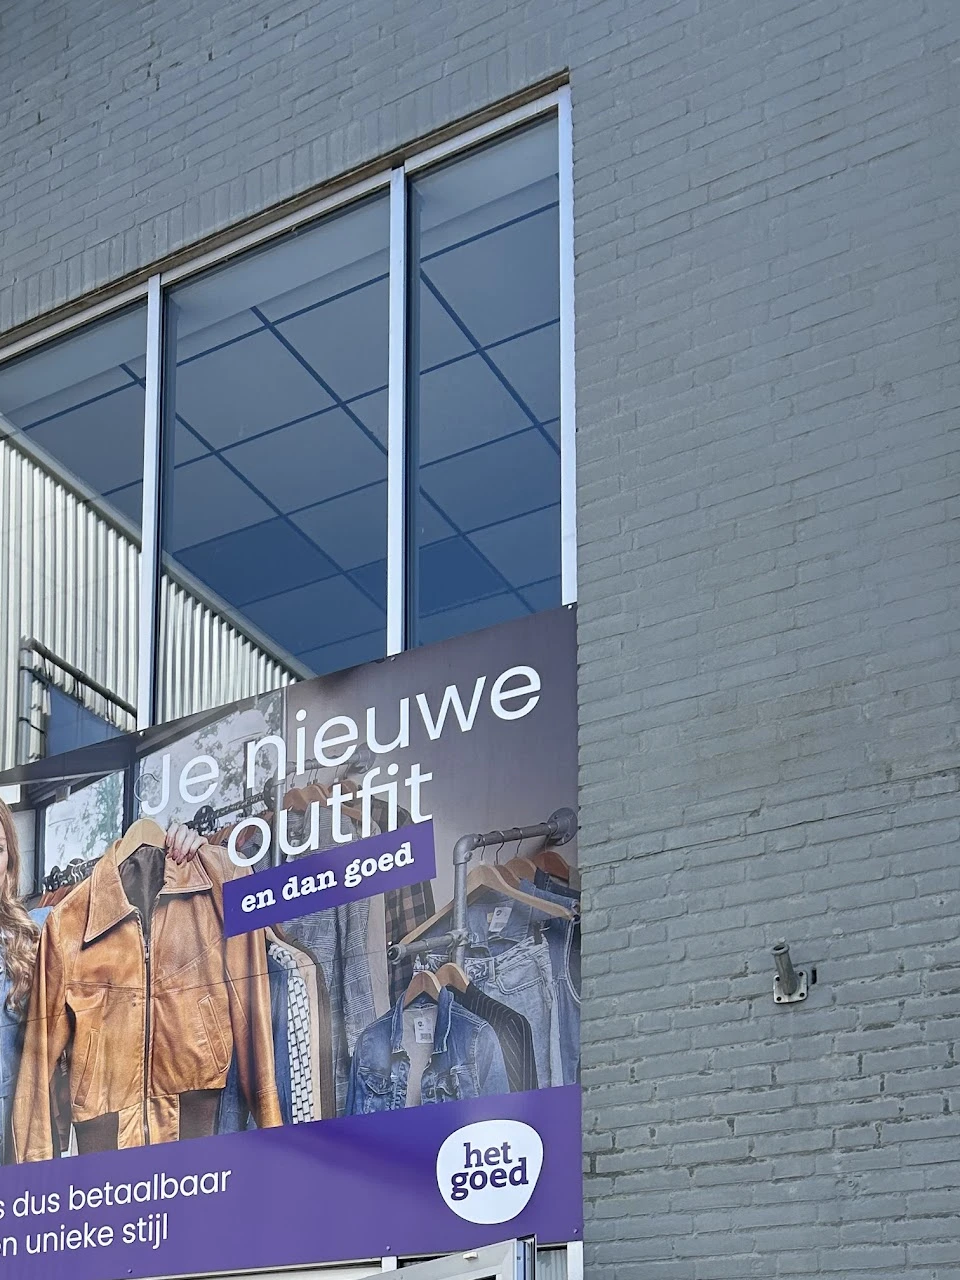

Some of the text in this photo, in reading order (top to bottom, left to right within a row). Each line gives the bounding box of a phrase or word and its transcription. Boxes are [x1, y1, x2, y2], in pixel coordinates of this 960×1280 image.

[141, 664, 542, 816] Je nieuwe
[227, 762, 433, 868] outfit
[241, 842, 415, 914] en dan goed
[450, 1156, 529, 1201] goed
[463, 1141, 513, 1168] het
[12, 1190, 60, 1219] dus
[68, 1167, 232, 1211] betaalbaar
[26, 1222, 114, 1255] unieke
[122, 1213, 169, 1250] stijl
